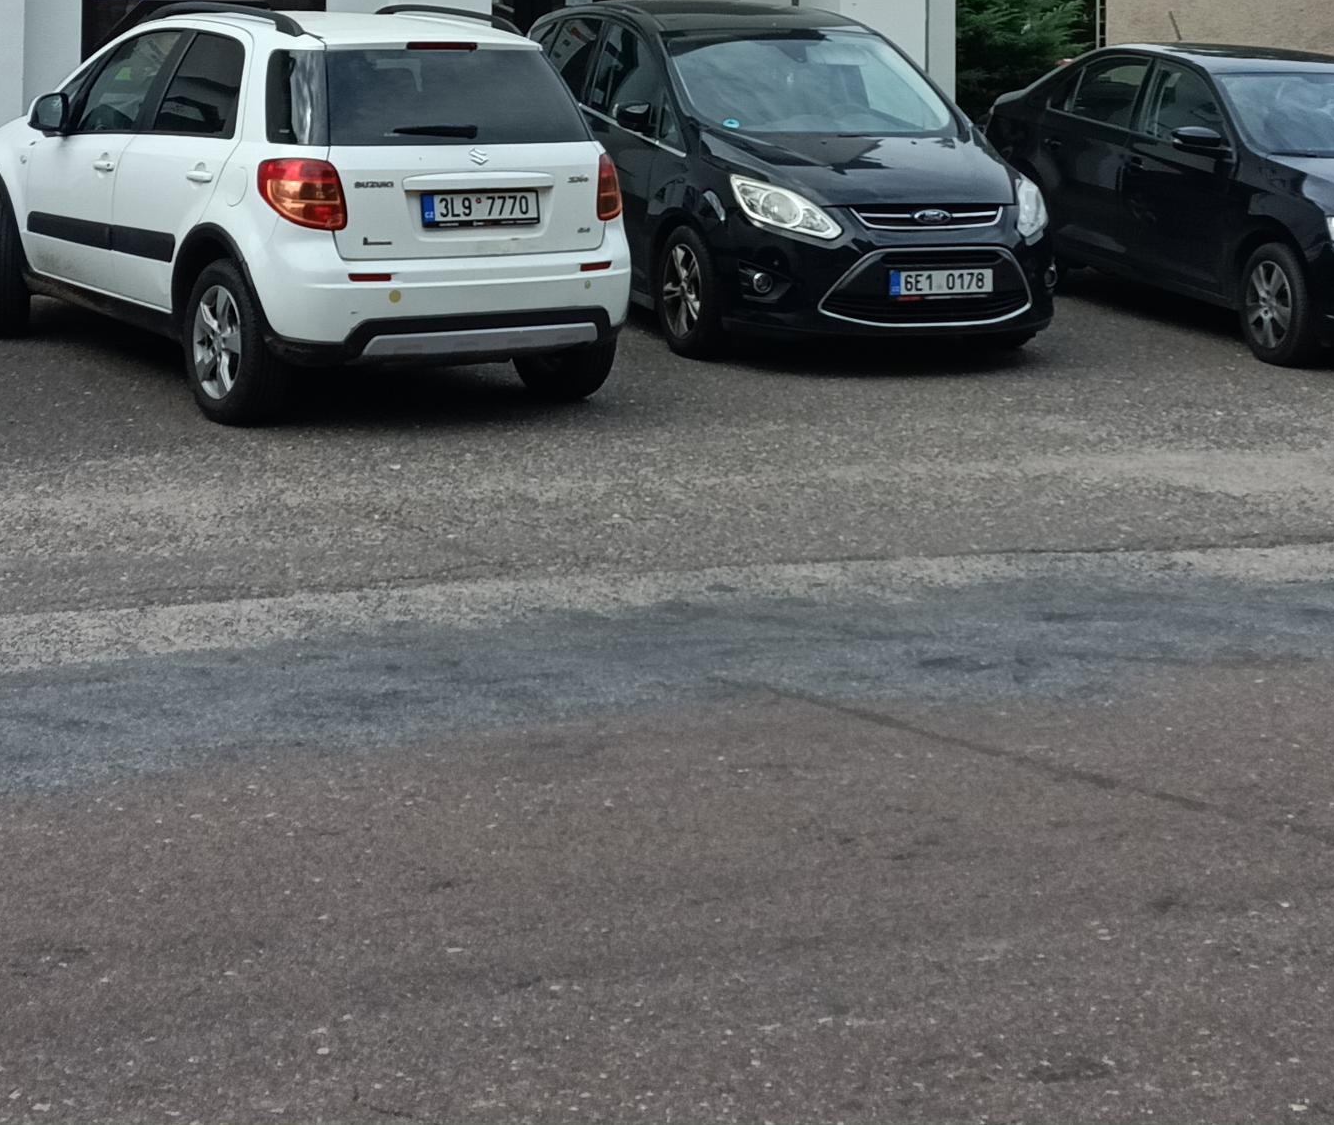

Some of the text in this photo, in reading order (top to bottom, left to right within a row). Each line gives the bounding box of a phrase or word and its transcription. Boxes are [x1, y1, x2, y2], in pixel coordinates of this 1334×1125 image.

[439, 195, 529, 218] 3L9 7770
[904, 272, 985, 292] 6E1 0178
